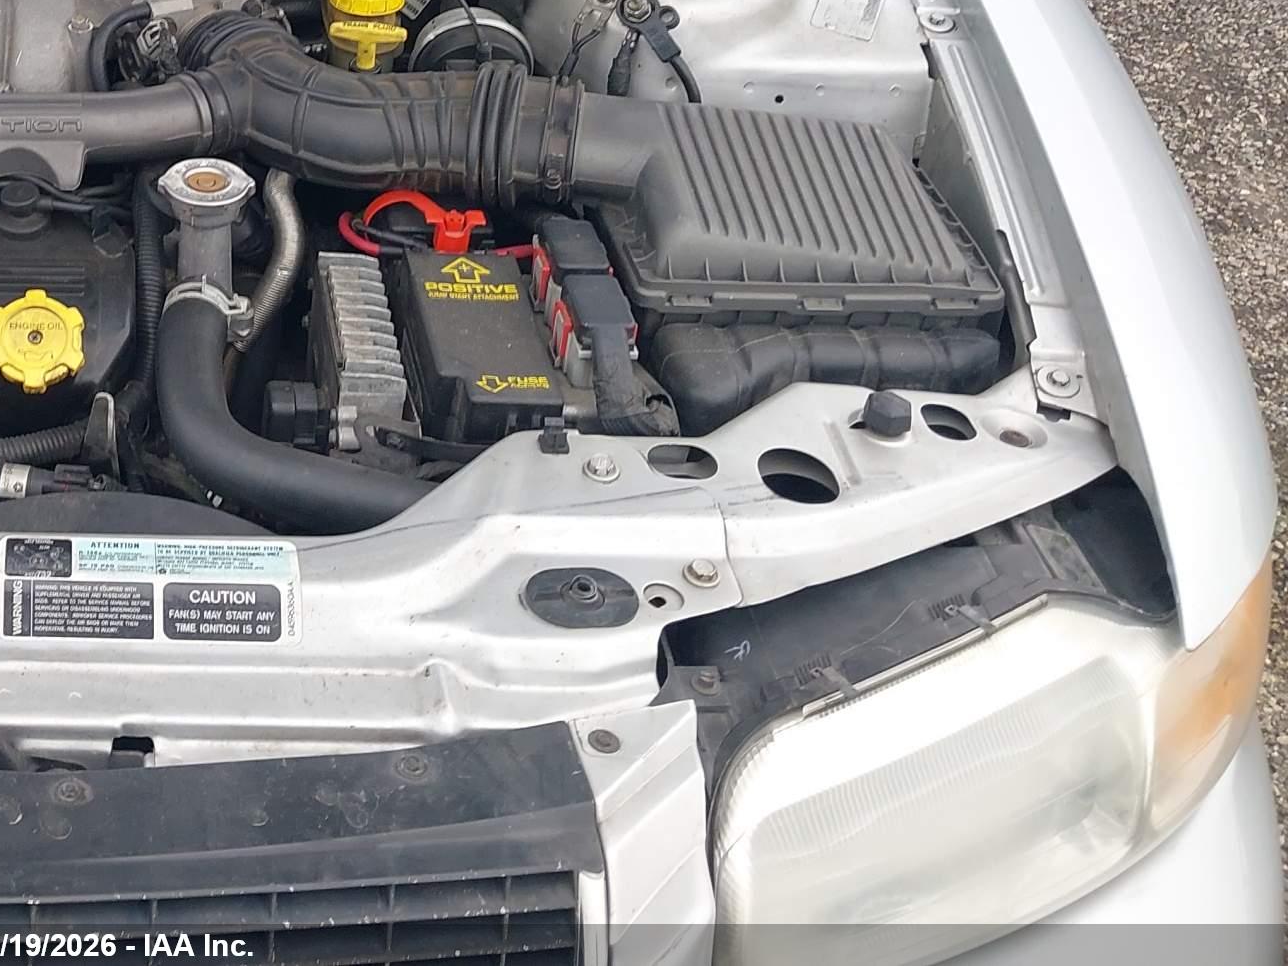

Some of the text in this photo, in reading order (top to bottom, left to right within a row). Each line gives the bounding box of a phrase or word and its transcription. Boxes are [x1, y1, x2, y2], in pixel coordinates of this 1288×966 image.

[424, 281, 518, 294] POSITIVE
[9, 321, 63, 331] ENGINE OIL
[507, 376, 549, 385] FUSE
[91, 541, 140, 549] ATTENTION
[189, 589, 256, 605] CAUTION
[12, 580, 23, 635] WARNING
[168, 609, 275, 622] FAN(S) MAY START ANY
[175, 623, 270, 635] TIME IGNITION IS ON
